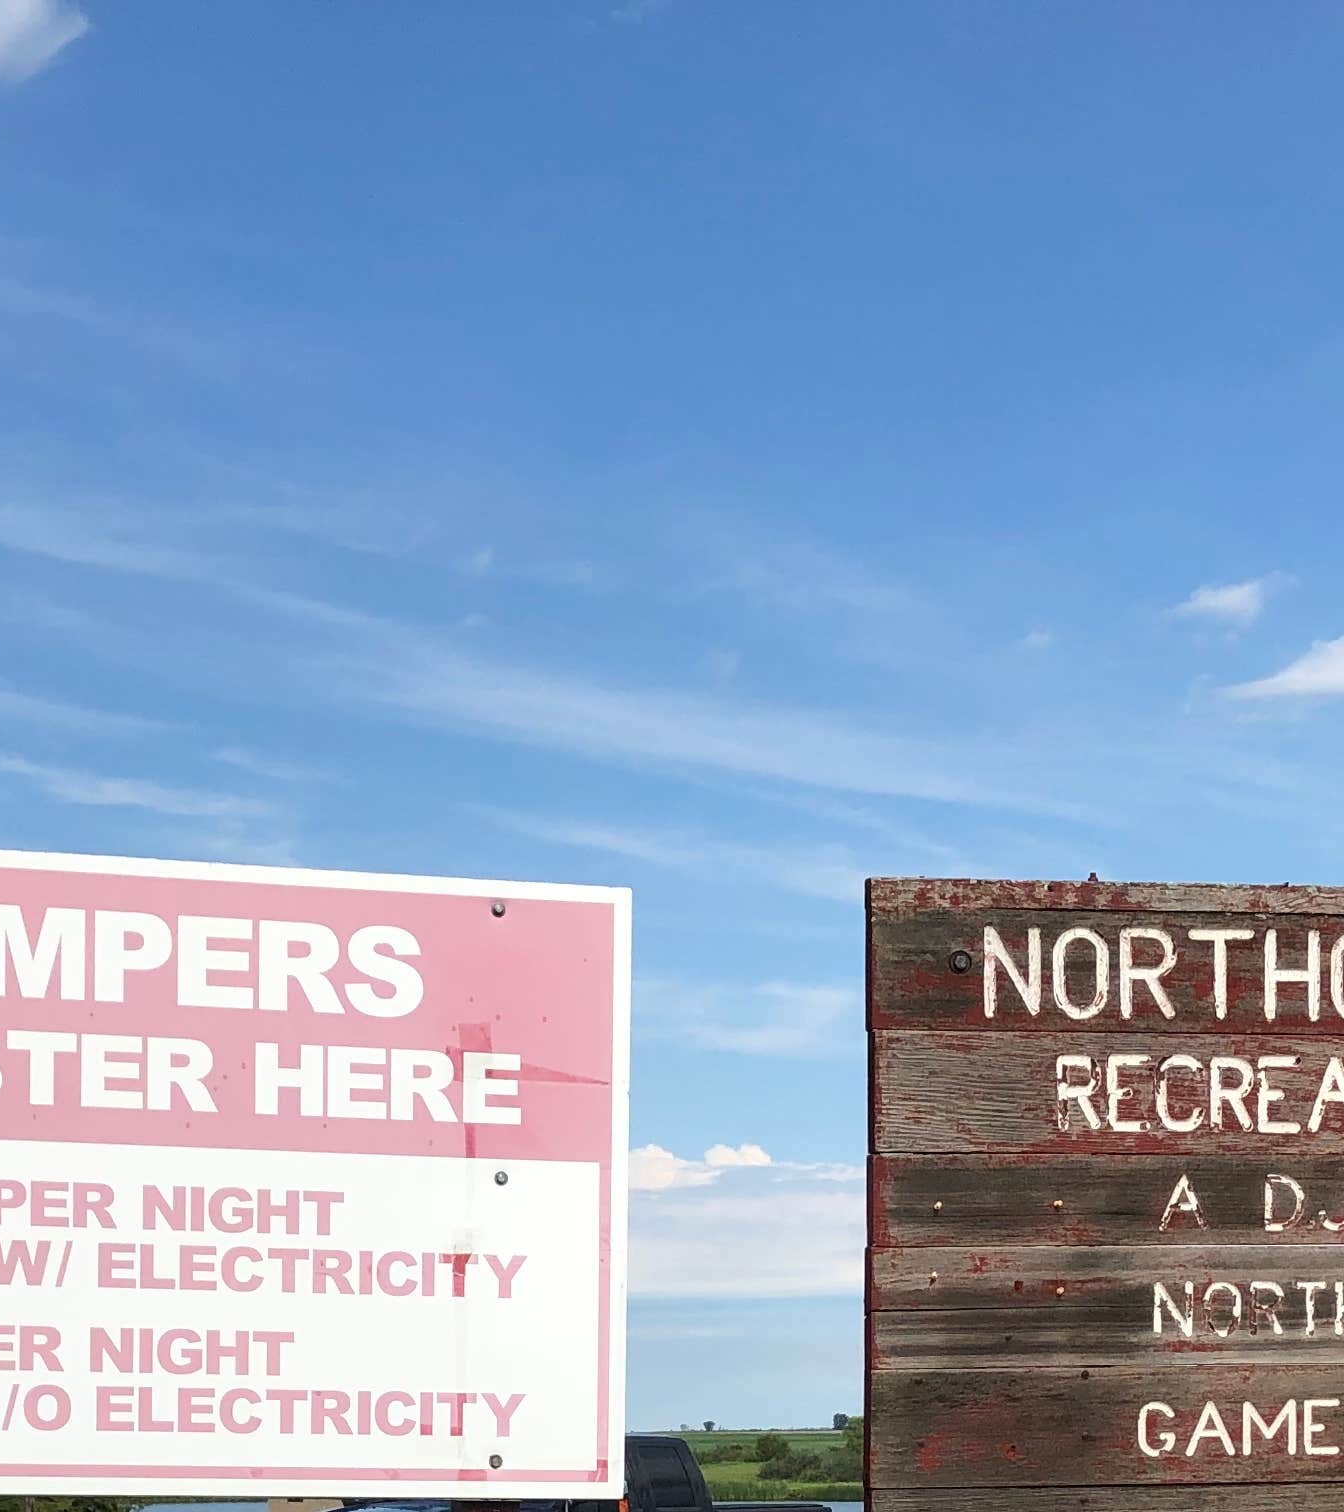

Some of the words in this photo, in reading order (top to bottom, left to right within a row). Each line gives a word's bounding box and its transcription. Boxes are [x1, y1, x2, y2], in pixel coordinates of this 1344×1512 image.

[255, 1042, 521, 1125] HERE
[143, 1185, 344, 1235] NIGHT
[1158, 1174, 1209, 1231] A
[98, 1243, 527, 1298] ELECTRICITY
[90, 1327, 294, 1376] NIGHT
[96, 1386, 525, 1437] ELECTRICITY
[1138, 1399, 1340, 1457] GAME
